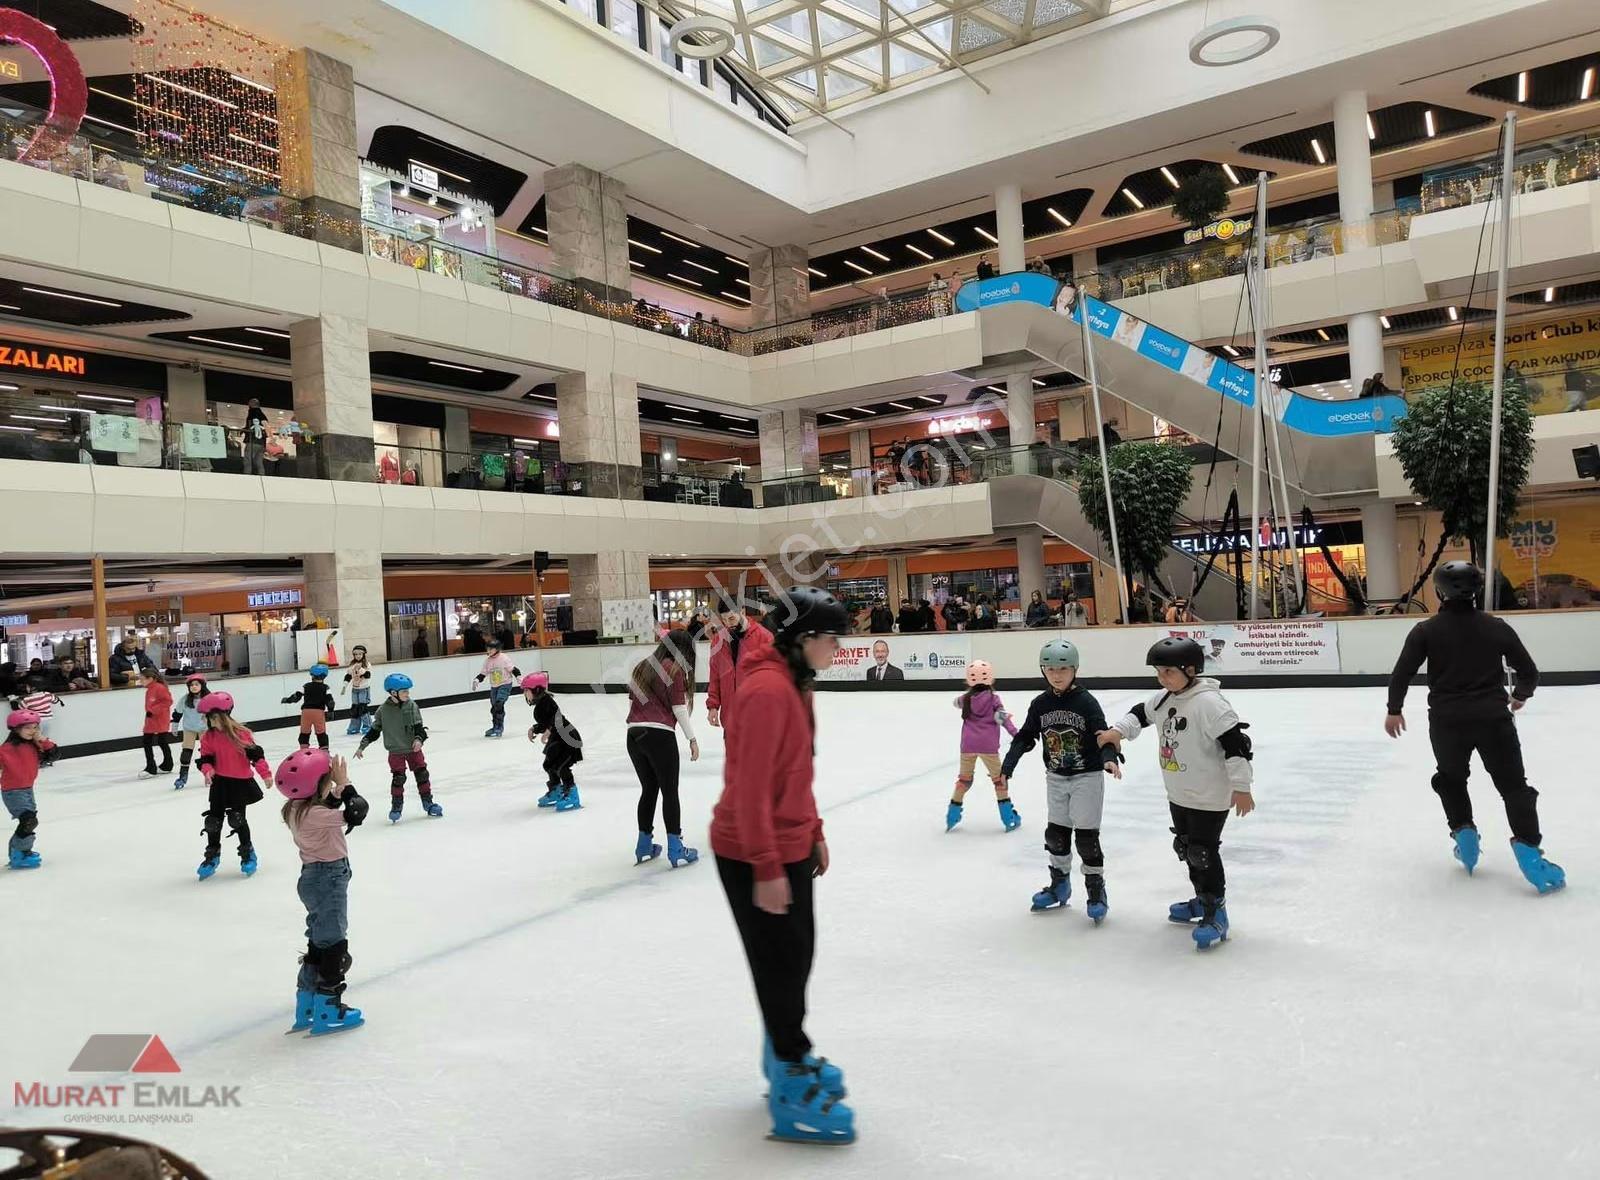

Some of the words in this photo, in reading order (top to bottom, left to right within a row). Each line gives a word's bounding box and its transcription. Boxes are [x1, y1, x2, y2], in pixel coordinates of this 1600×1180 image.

[1328, 411, 1371, 423] ebebek
[1248, 623, 1282, 631] yükselen
[1234, 640, 1280, 648] Cumhuriyeti
